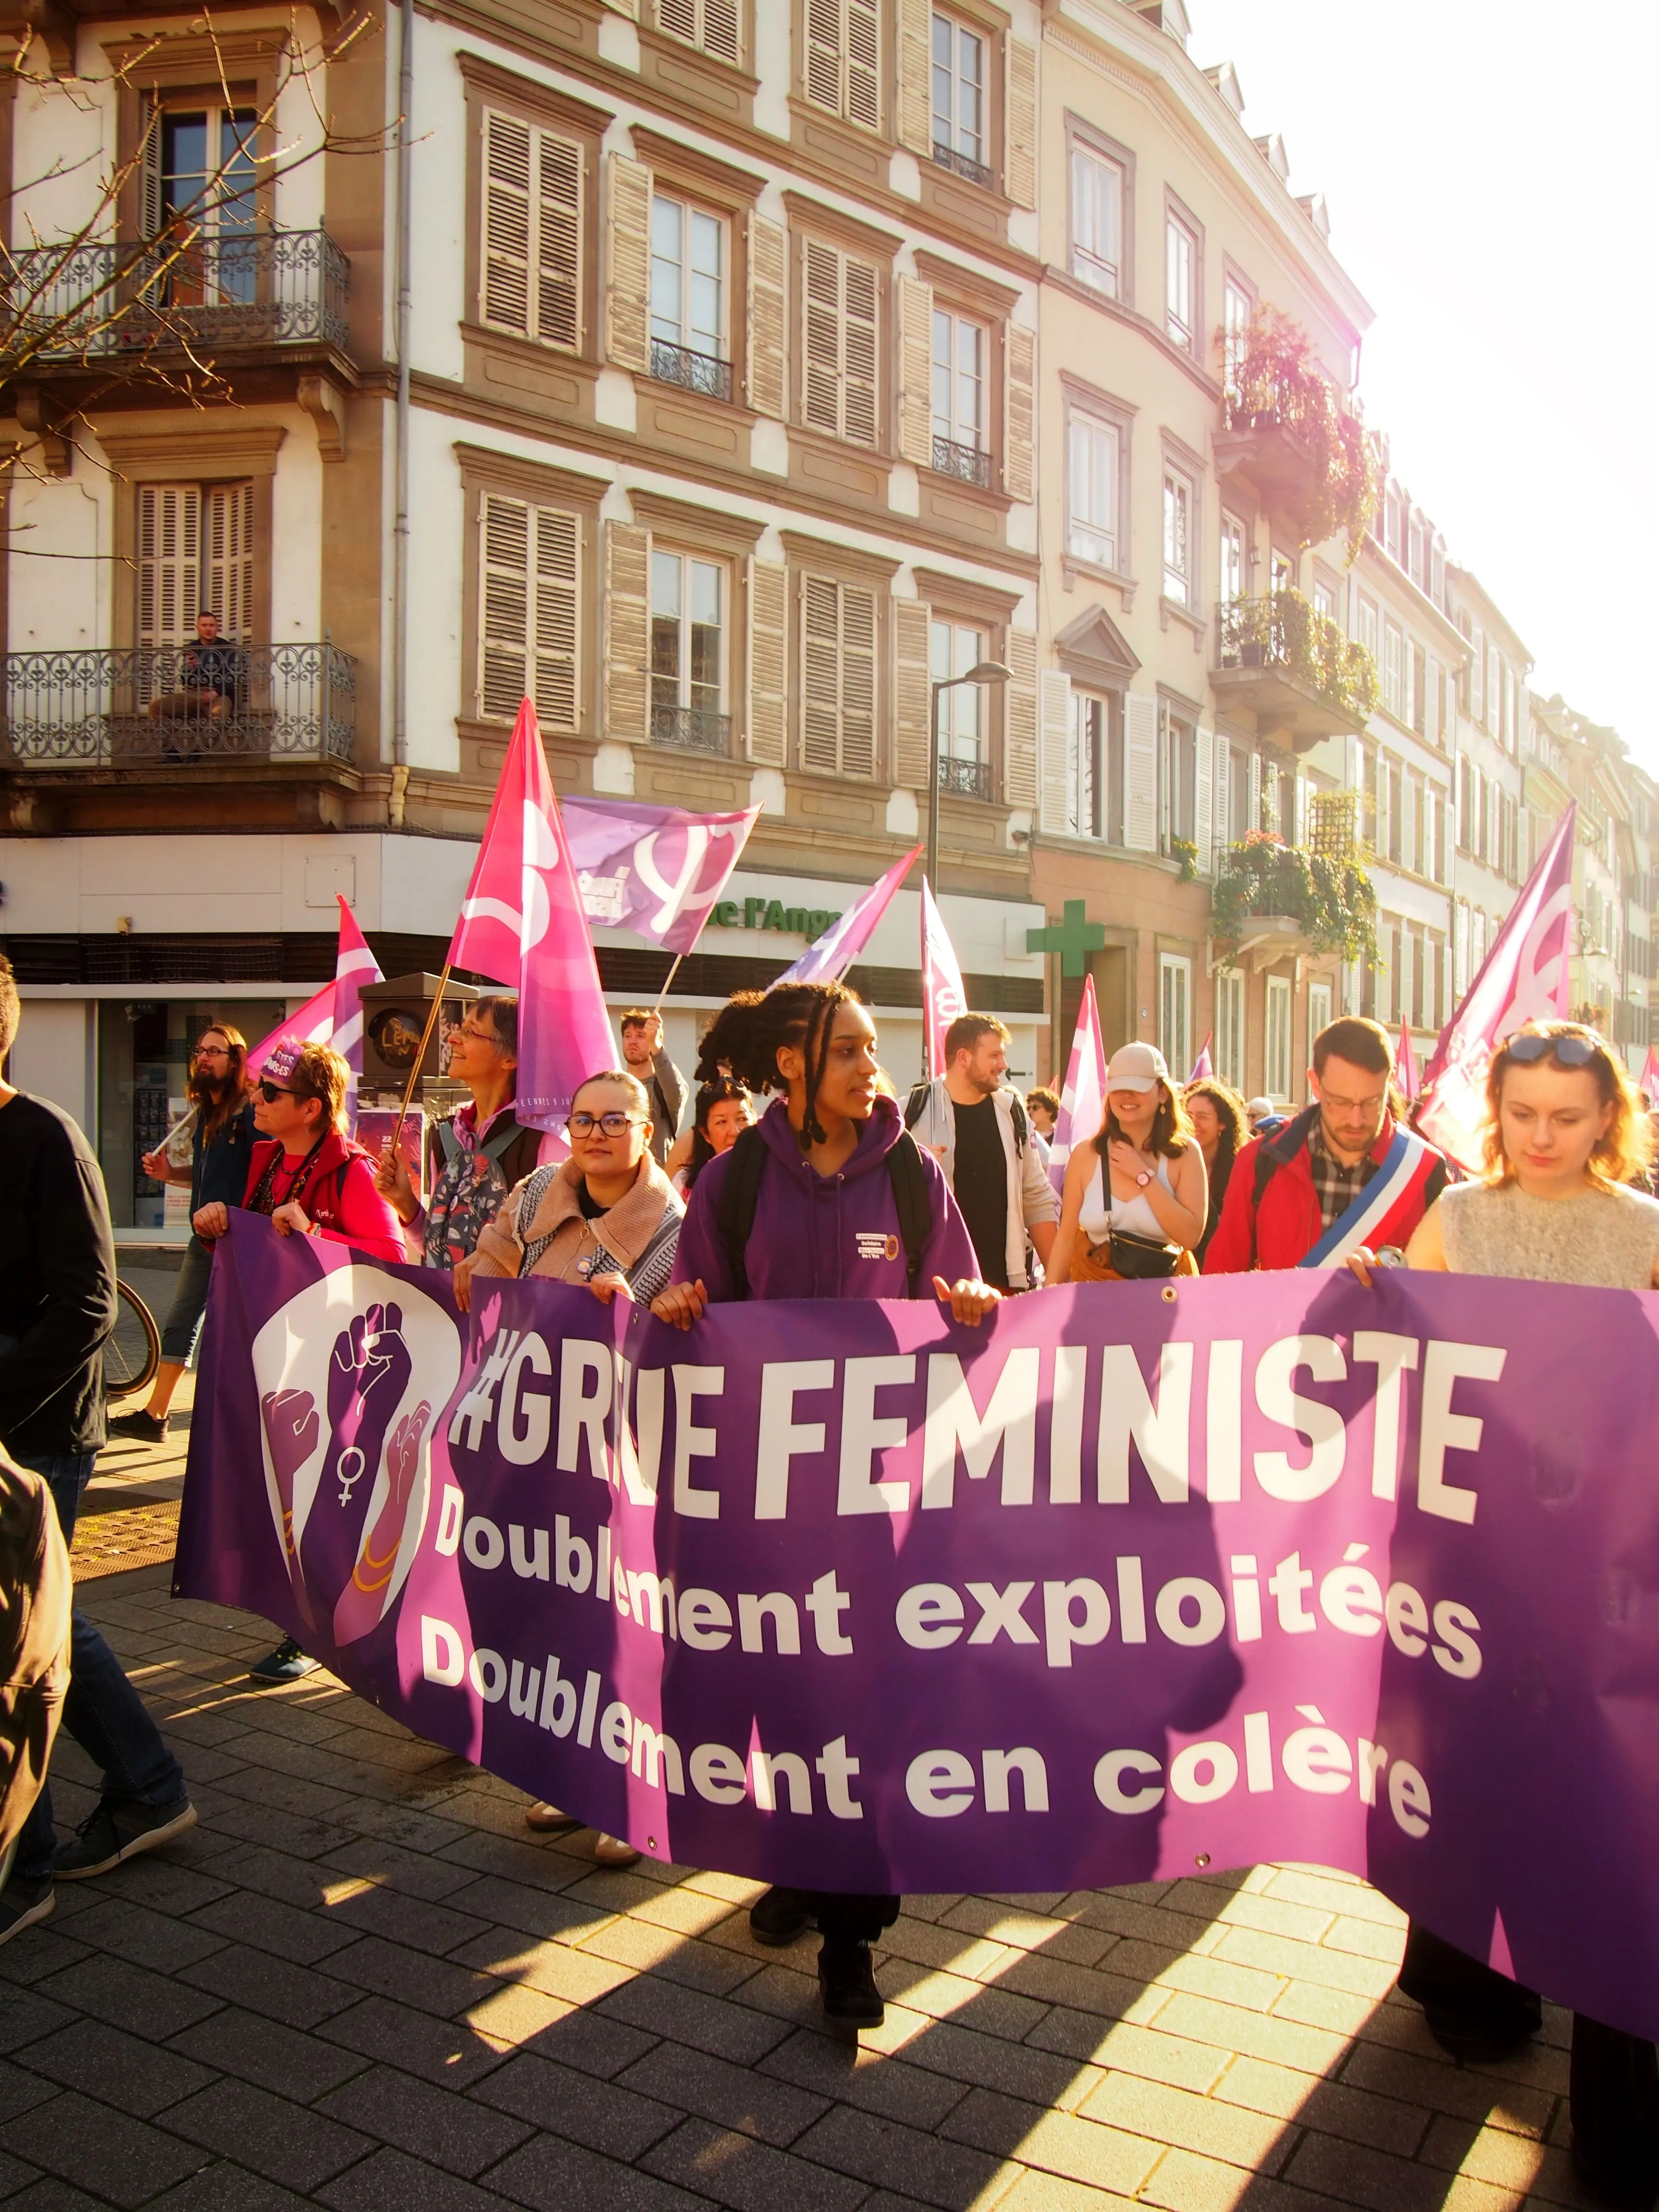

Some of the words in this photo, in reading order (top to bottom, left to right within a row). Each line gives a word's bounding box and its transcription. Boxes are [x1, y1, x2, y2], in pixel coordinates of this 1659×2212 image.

[448, 1328, 725, 1520] #GRVE
[754, 1331, 1508, 1526] FEMINISTE
[435, 1483, 854, 1656] Doublement
[895, 1542, 1483, 1680] exploitées
[421, 1614, 864, 1819] Doublement
[905, 1746, 1050, 1818] en
[1093, 1704, 1432, 1840] colère
